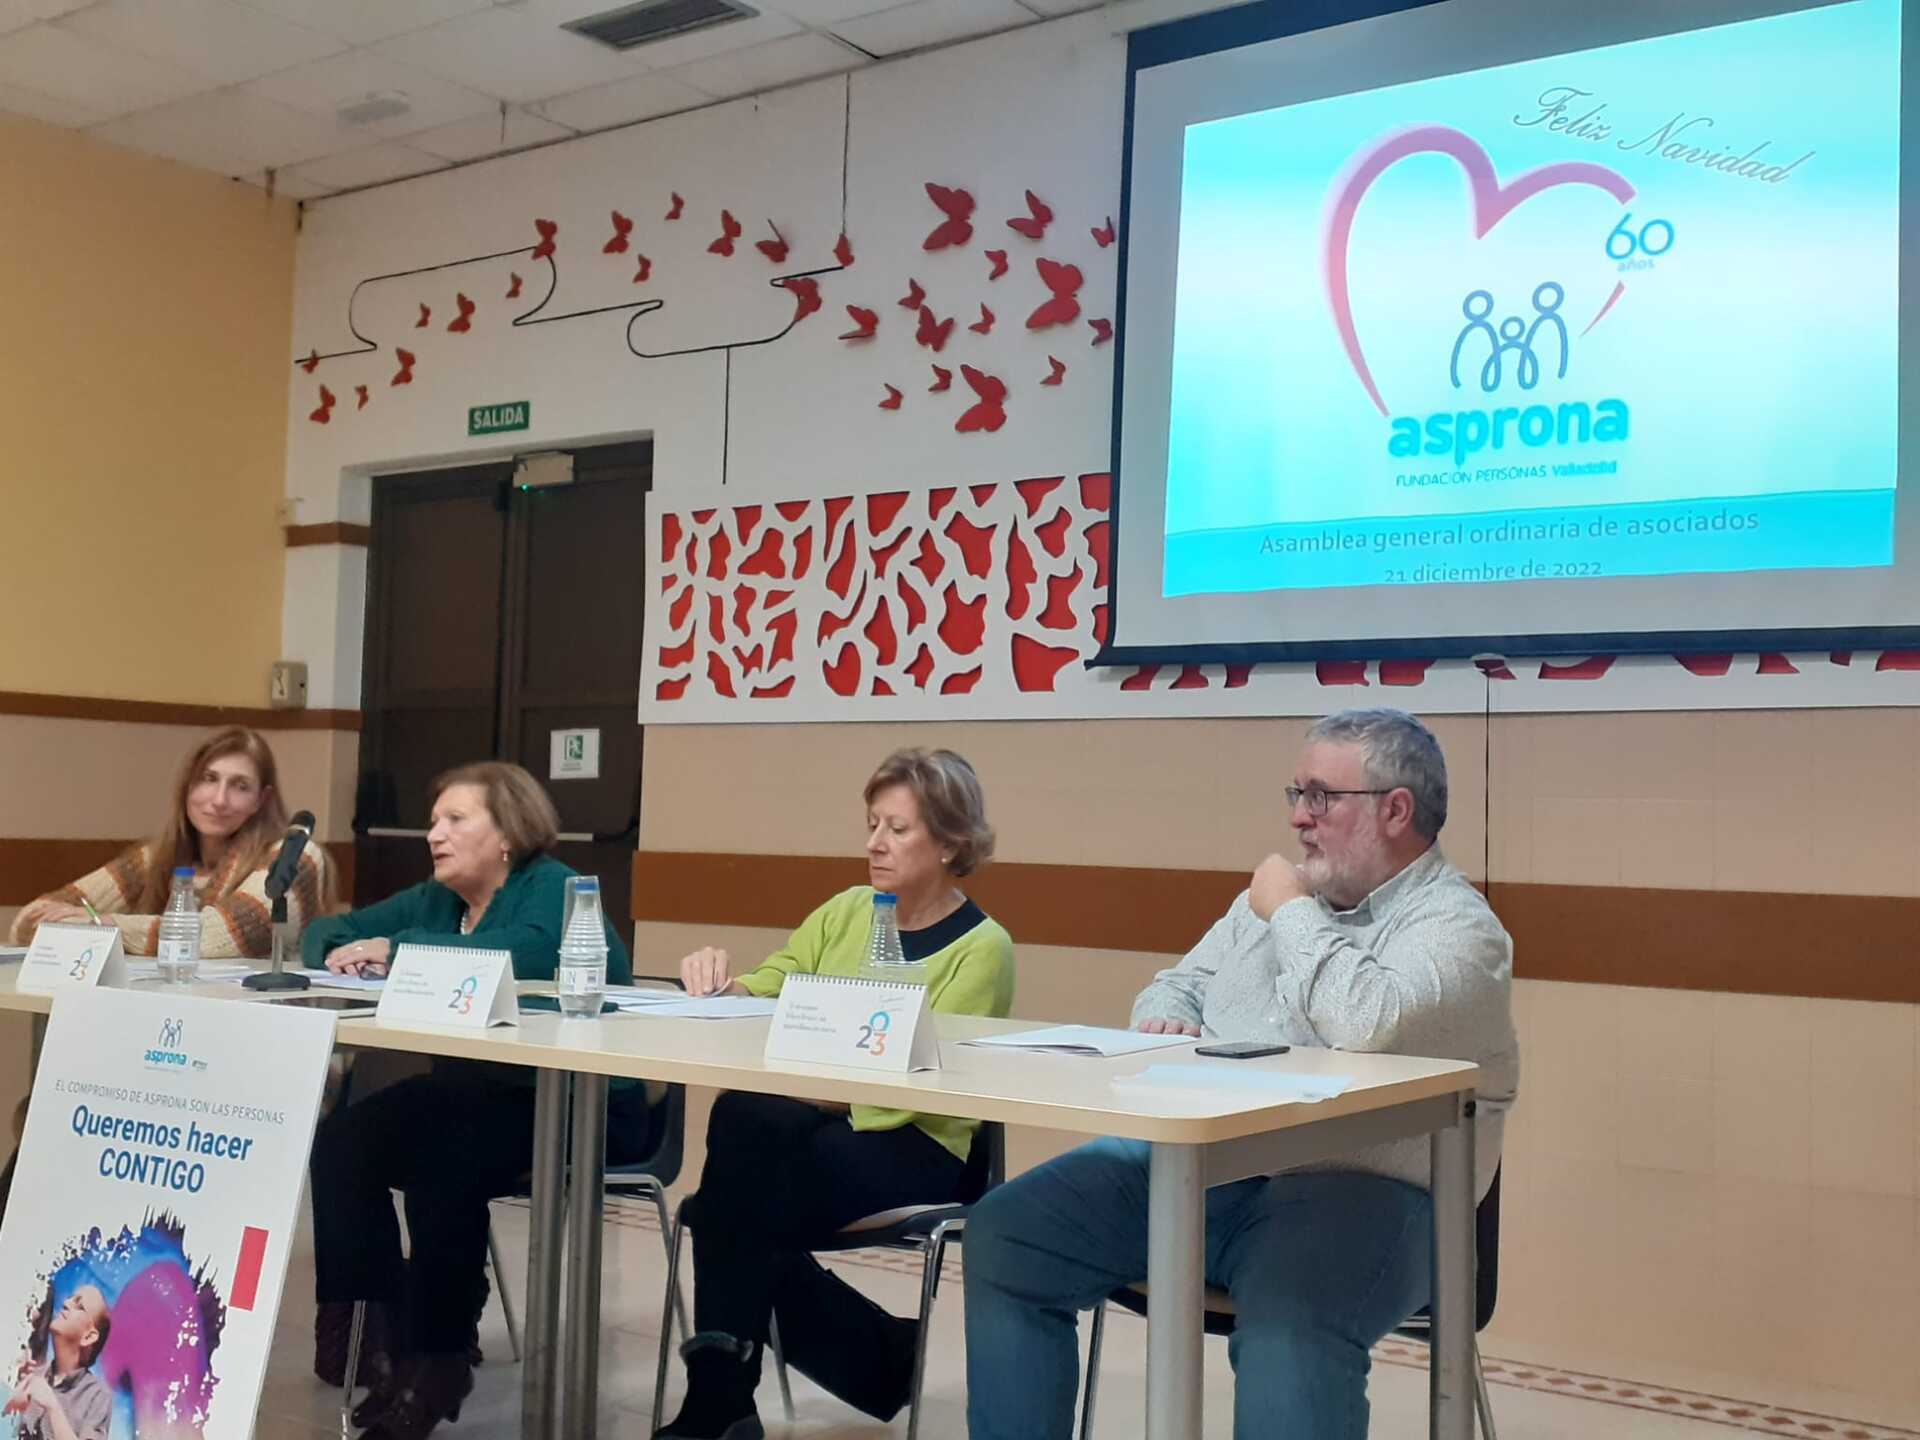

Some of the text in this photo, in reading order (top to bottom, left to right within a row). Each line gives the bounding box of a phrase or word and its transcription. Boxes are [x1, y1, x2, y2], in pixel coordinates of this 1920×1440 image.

[1513, 87, 1816, 184] Feliz Navidad
[1605, 212, 1675, 260] 60
[473, 405, 524, 429] SALIDA
[1388, 398, 1630, 468] asprona
[1475, 464, 1547, 483] PERSONAS
[1260, 507, 1760, 554] Asamblea general ordinaria de asociados
[1384, 558, 1602, 583] 21 diciembre de 2022
[143, 1048, 188, 1066] asprona
[55, 1079, 285, 1125] EL COMPROMISO DE ASPRONA SON LAS PERSONAS
[72, 1104, 253, 1161] Queremos hacer
[99, 1147, 205, 1193] CONTIGO
